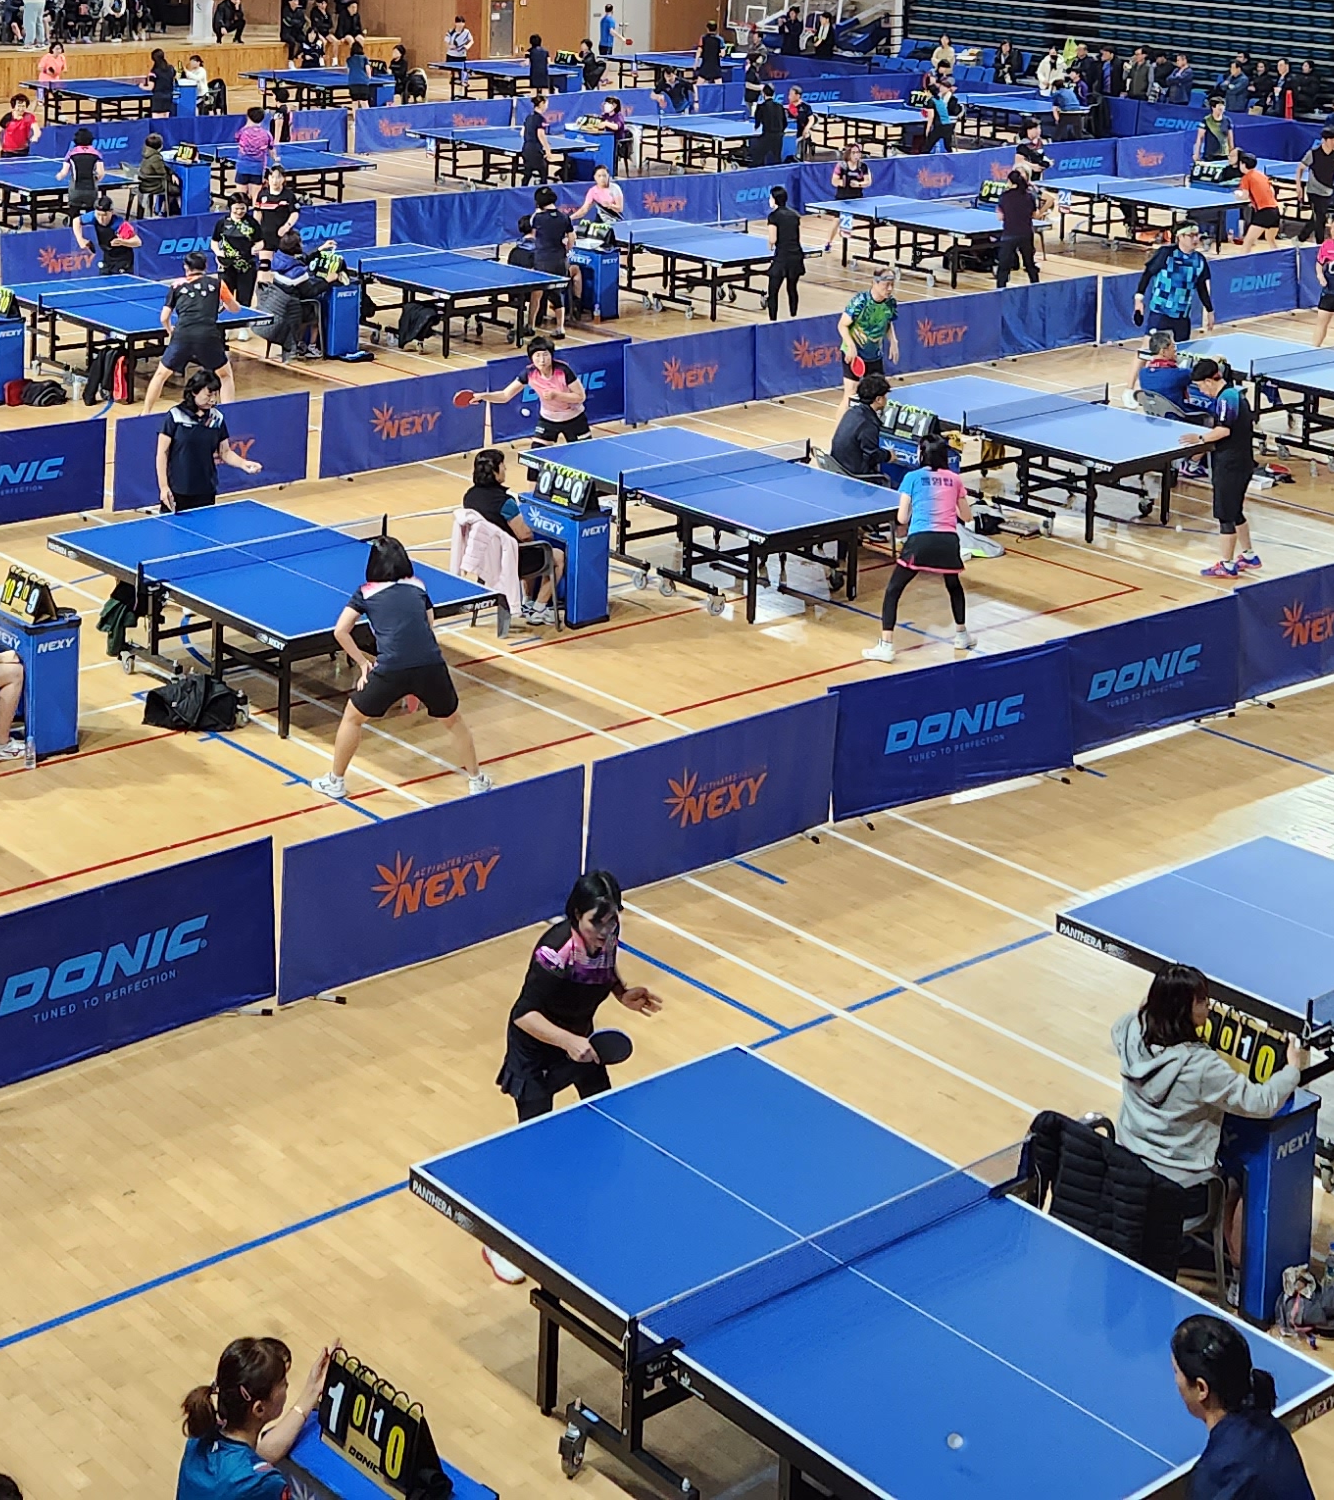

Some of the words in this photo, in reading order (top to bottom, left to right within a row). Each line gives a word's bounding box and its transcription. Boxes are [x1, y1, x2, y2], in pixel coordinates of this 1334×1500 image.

[1057, 156, 1104, 171] DONIC
[1058, 190, 1072, 205] 24
[158, 236, 212, 255] DON
[299, 221, 353, 241] ONIC
[1230, 272, 1283, 293] DONIC
[924, 326, 968, 347] NEXY
[673, 364, 719, 390] NEXY
[382, 410, 442, 441] NEXY
[539, 471, 551, 494] 0
[571, 481, 584, 504] 0
[534, 517, 565, 534] NEXY
[582, 523, 608, 539] NEXY
[37, 637, 75, 654] NEXY
[1086, 644, 1204, 703] DONIC
[883, 693, 1025, 755] DONIC
[907, 750, 938, 763] TUNED
[953, 734, 1005, 752] PERFECTION
[680, 772, 768, 829] NEXY
[413, 857, 461, 879] ACTIVATES
[393, 853, 501, 919] NEXY
[1059, 923, 1104, 950] PANTHERA
[33, 1006, 77, 1026] TUNED
[83, 998, 100, 1011] TO
[104, 969, 178, 1004] PERFECTION
[1254, 1045, 1276, 1084] 0
[1277, 1127, 1314, 1160] NEXY
[411, 1181, 452, 1219] PANTHERA
[326, 1380, 346, 1436] 1
[352, 1393, 366, 1428] 0
[371, 1406, 385, 1442] 1
[385, 1424, 406, 1480] 0
[348, 1444, 380, 1477] DONIC
